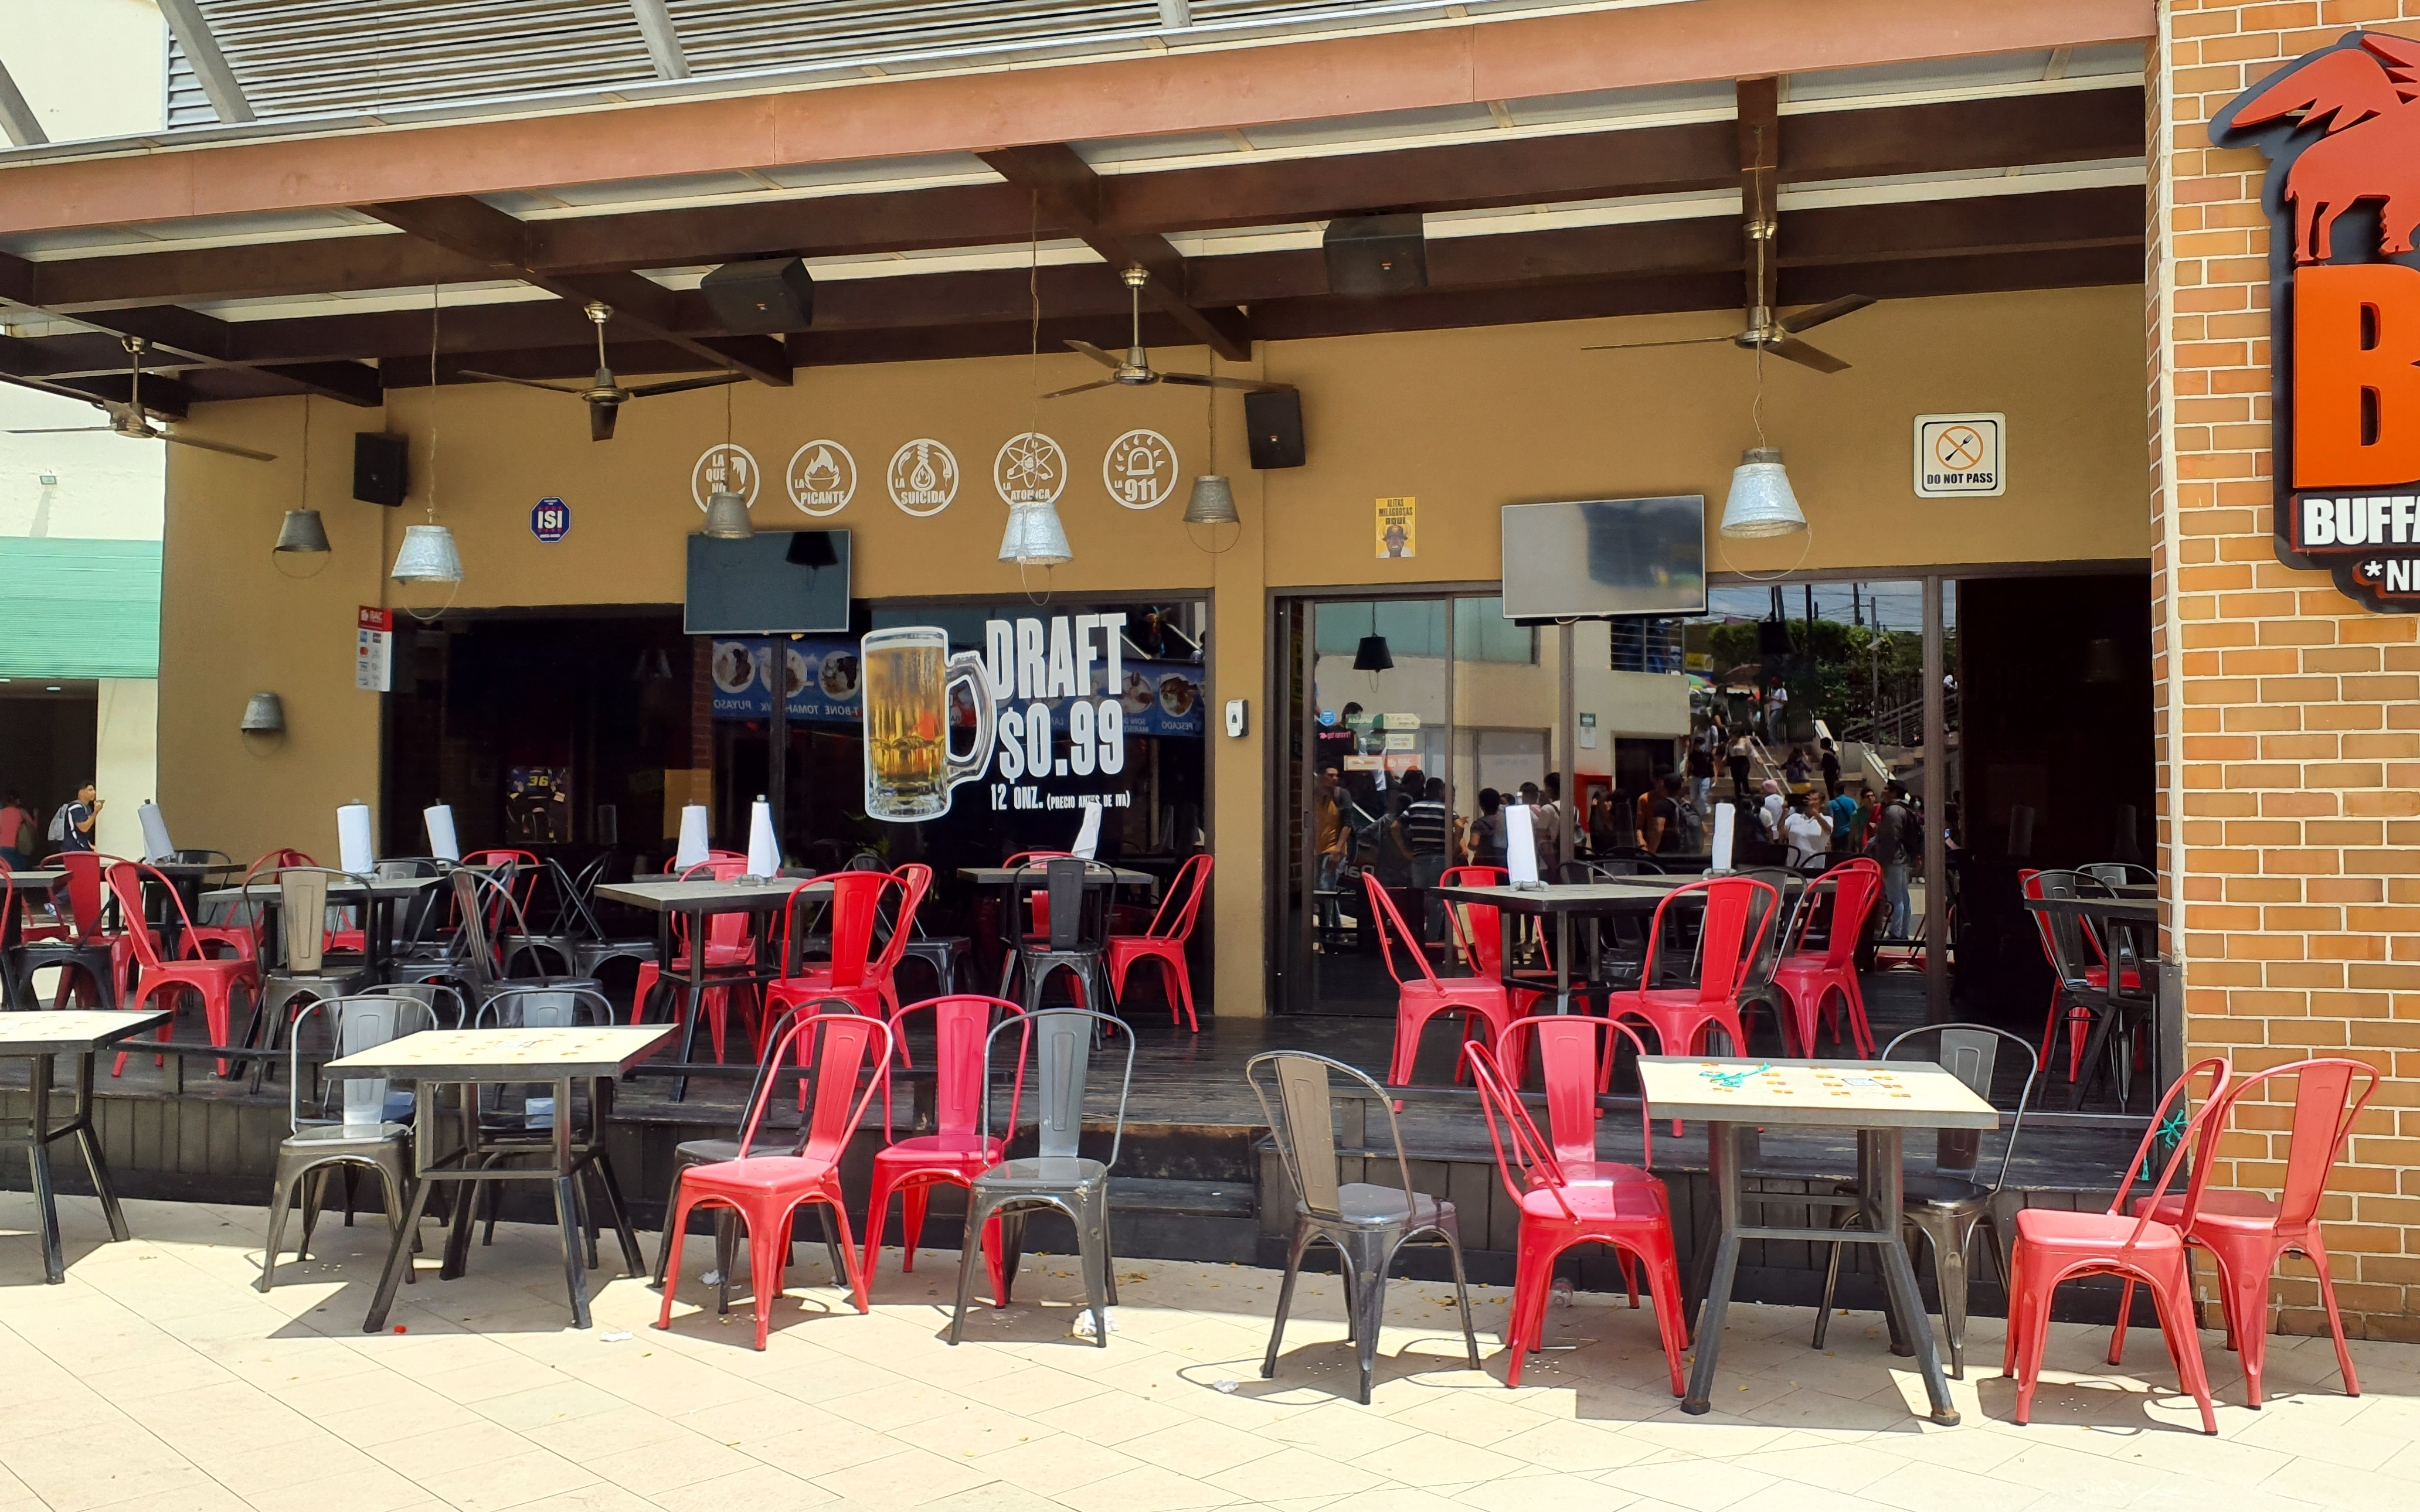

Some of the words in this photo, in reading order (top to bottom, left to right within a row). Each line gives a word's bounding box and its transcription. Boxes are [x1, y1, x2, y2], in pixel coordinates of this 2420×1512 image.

[712, 454, 725, 467] LA
[705, 468, 726, 482] QUE
[1927, 474, 1941, 485] DO
[1943, 474, 1964, 484] NOT
[1966, 472, 1993, 483] PASS
[794, 479, 804, 489] LA
[895, 478, 905, 488] LA
[1002, 482, 1011, 491] LA
[1115, 480, 1123, 488] LA
[1124, 478, 1157, 502] 911
[800, 491, 844, 505] PICANTE
[900, 491, 945, 505] SUICIDA
[1387, 499, 1404, 507] ALITAS
[1379, 507, 1413, 517] MILAGROSAS
[538, 510, 563, 529] ISI
[2304, 496, 2420, 545] BUFF
[986, 612, 1127, 700] DRAFT
[998, 699, 1124, 784] $0.99
[528, 775, 549, 786] 36
[991, 784, 1007, 811] 12
[1014, 786, 1044, 809] ONZ.
[1046, 793, 1075, 811] (PRECIO
[1078, 794, 1100, 808] ANTS
[1103, 794, 1113, 808] DE
[1115, 789, 1131, 809] IVA)
